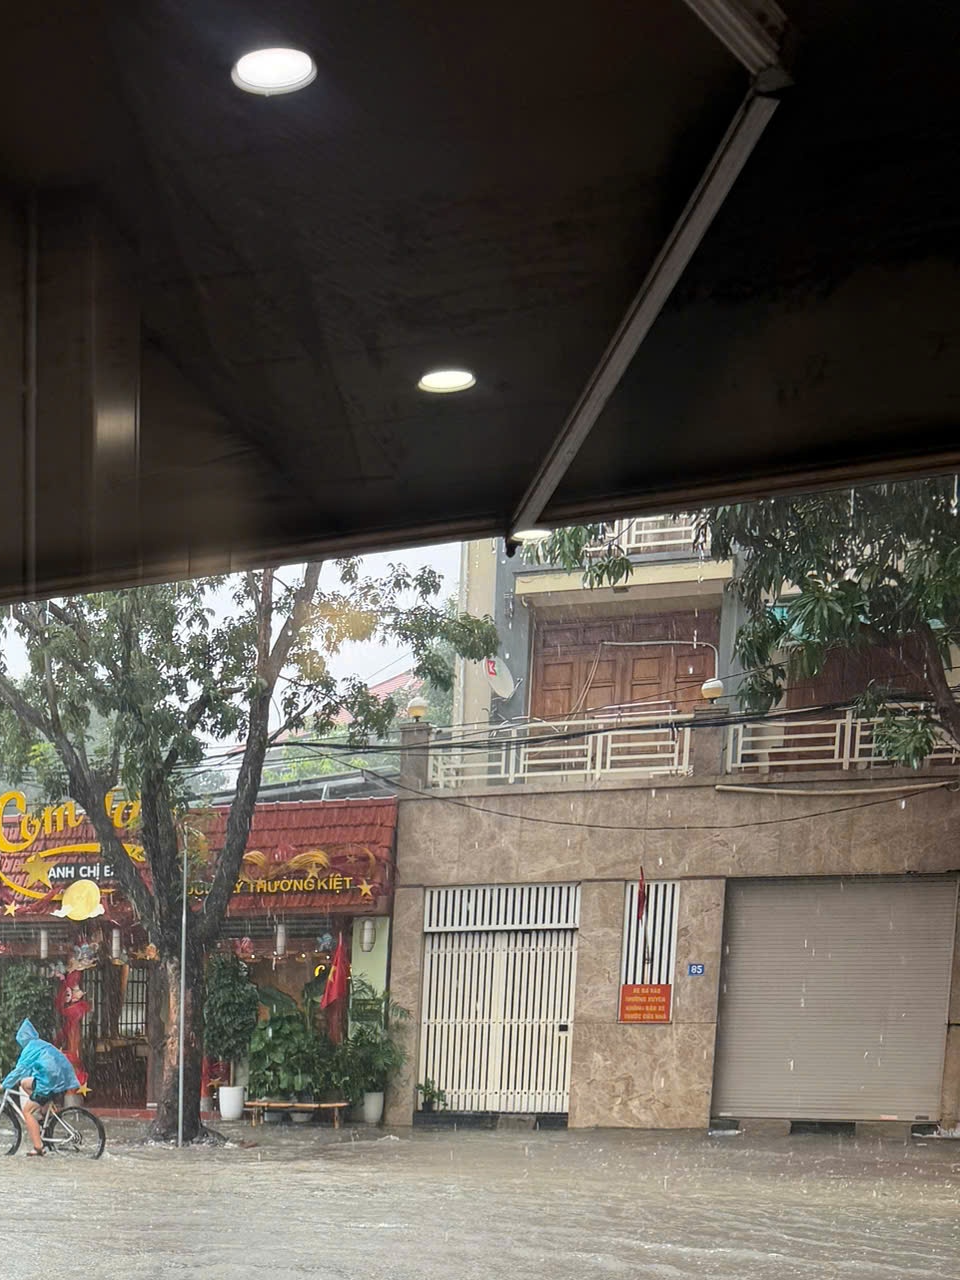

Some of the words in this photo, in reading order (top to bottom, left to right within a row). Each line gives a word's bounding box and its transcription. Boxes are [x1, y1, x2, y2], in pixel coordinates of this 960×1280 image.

[48, 866, 75, 879] ANH
[79, 862, 100, 880] CHỊ
[690, 965, 703, 974] 85
